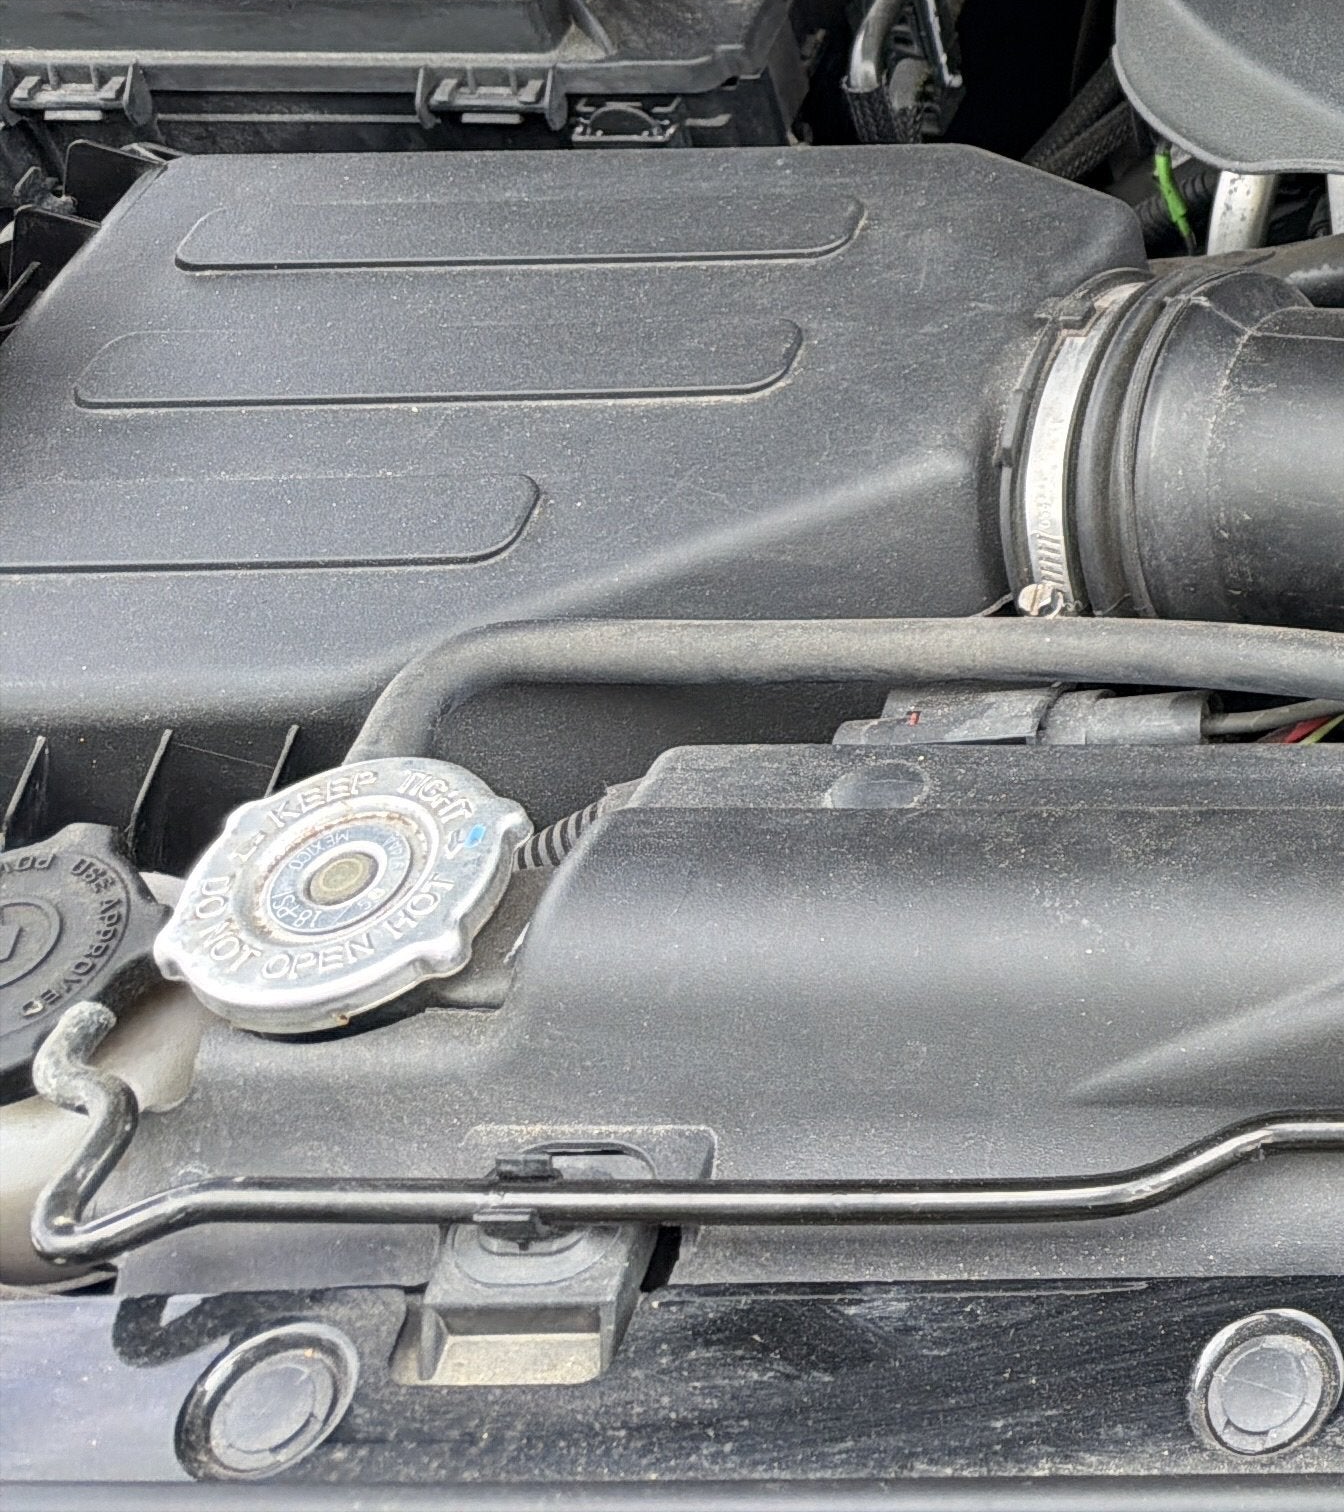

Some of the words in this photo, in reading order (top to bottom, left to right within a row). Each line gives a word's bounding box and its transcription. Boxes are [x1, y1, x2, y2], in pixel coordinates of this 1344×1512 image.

[267, 770, 378, 829] KEEP
[398, 769, 474, 824] TIGHT
[288, 830, 350, 870] MEXICO
[71, 857, 117, 895] USE
[195, 875, 230, 919] DO
[382, 872, 456, 940] HOT
[21, 898, 124, 1018] APPROVED
[199, 918, 263, 973] NOT
[261, 932, 375, 980] OPEN
